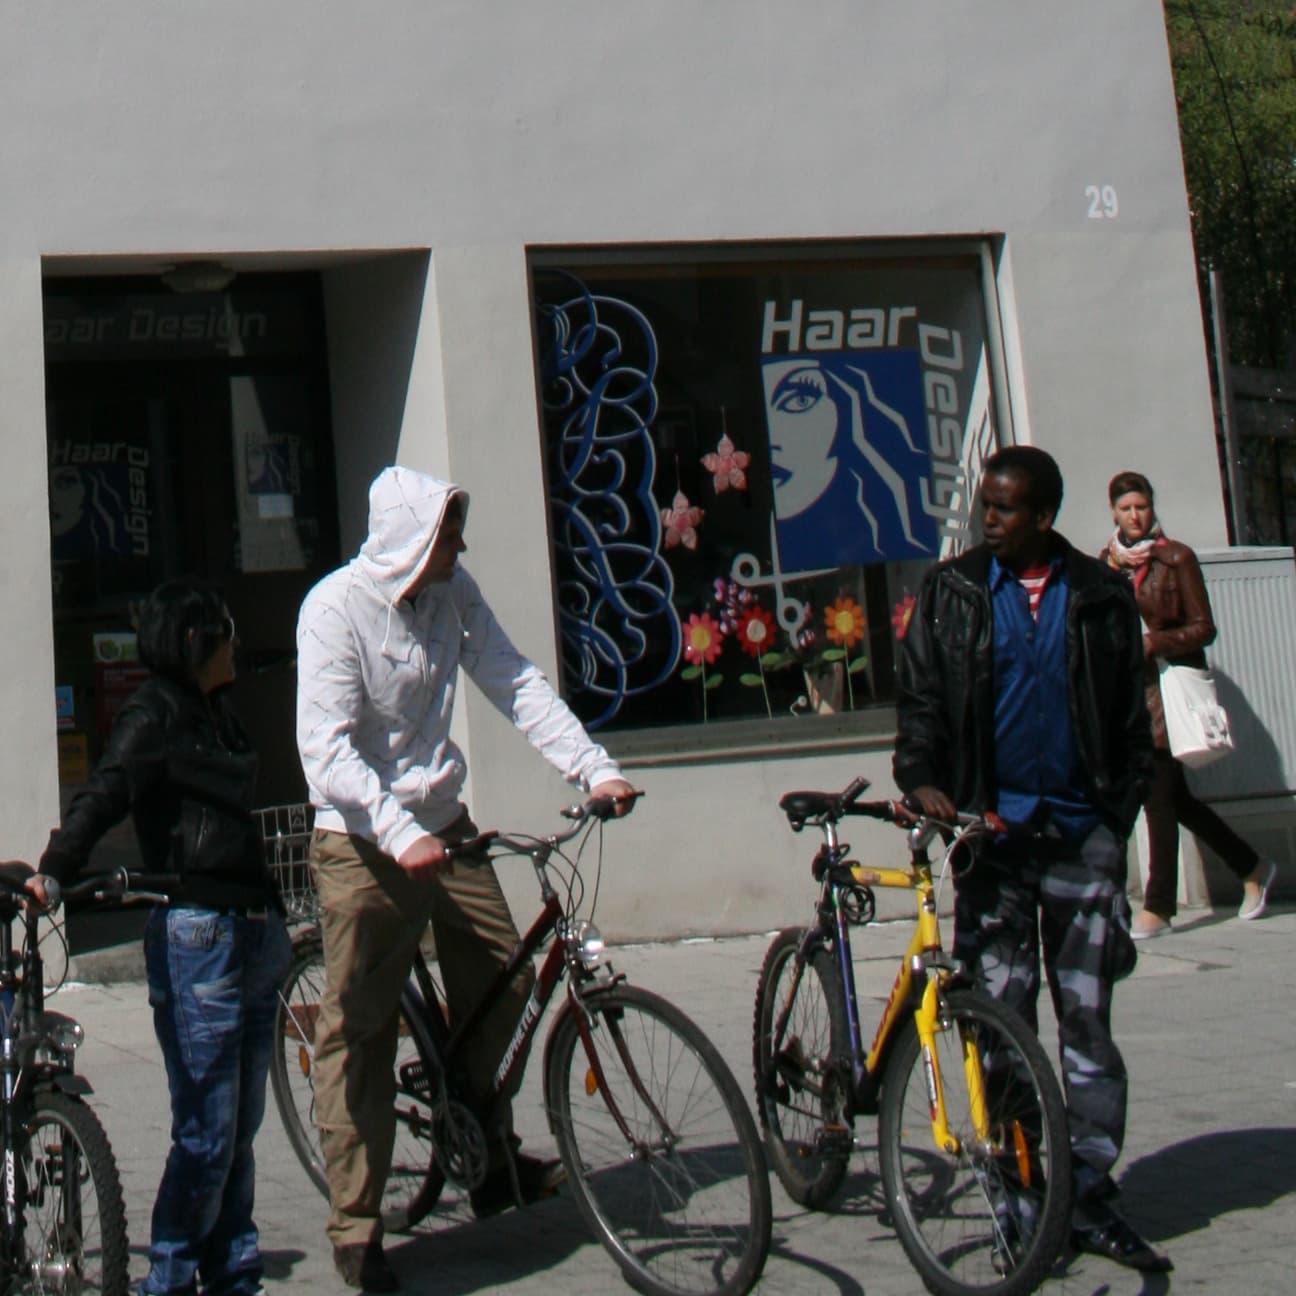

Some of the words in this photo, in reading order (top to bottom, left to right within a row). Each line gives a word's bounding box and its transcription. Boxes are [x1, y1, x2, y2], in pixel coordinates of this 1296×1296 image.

[1085, 184, 1120, 220] 29
[45, 315, 116, 344] aar
[129, 308, 267, 355] Design
[761, 299, 918, 353] Haar
[50, 440, 128, 465] Haar
[123, 445, 152, 556] Design
[6, 1149, 15, 1204] ZOOM
